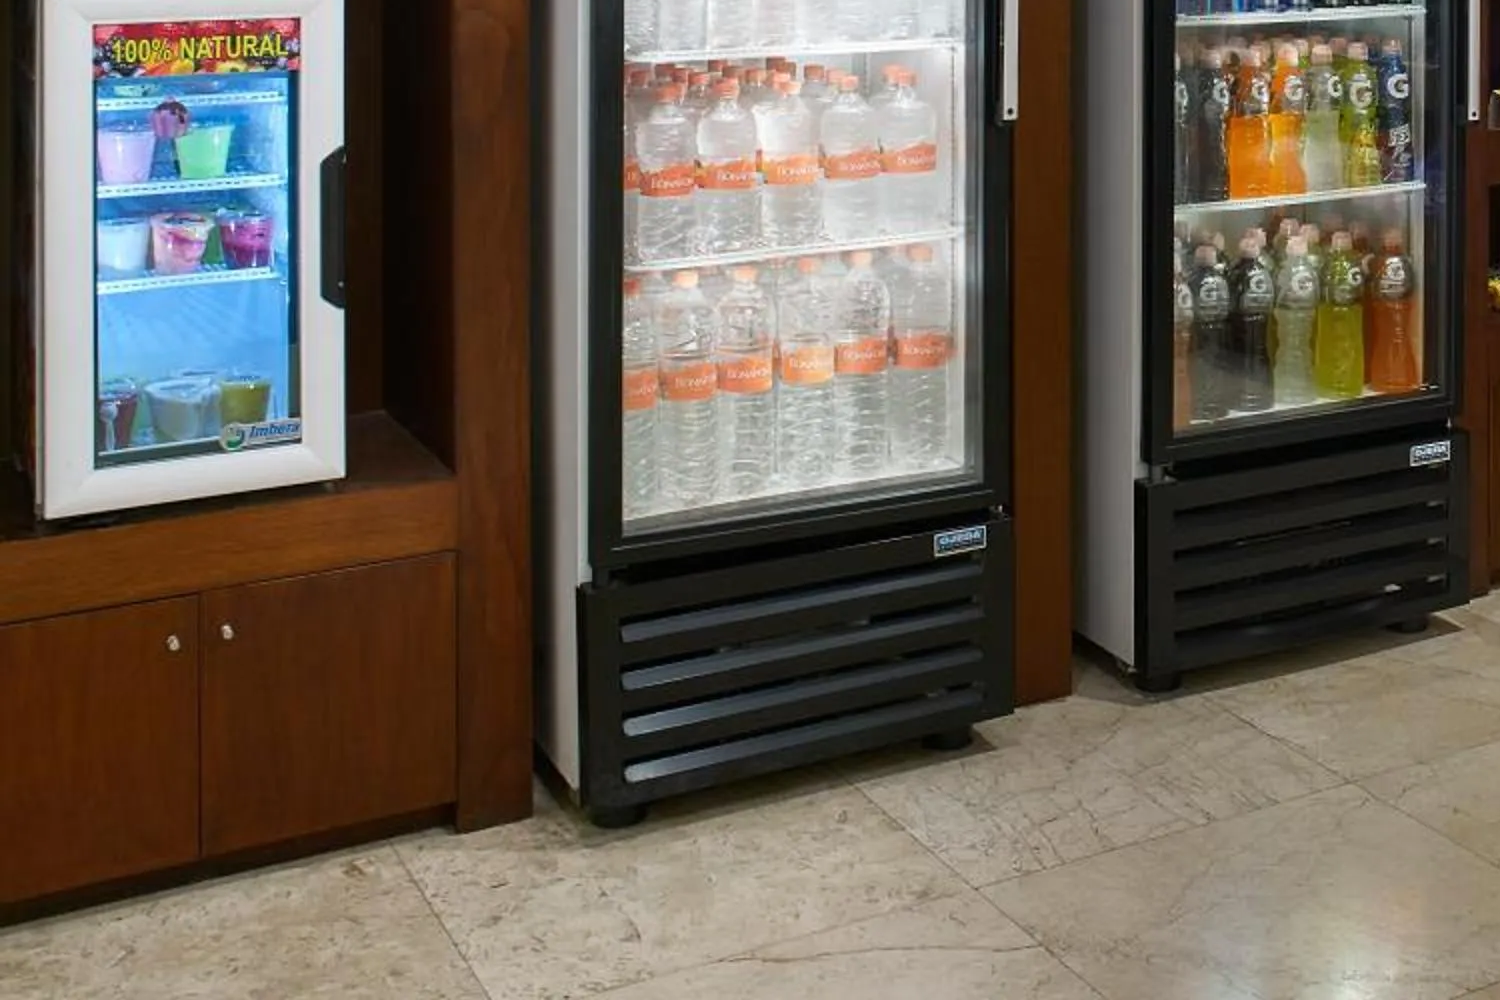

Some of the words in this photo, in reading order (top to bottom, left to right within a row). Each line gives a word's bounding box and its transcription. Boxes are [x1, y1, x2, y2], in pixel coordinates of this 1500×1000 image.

[111, 39, 173, 63] 100%
[179, 33, 289, 60] NATURAL
[1349, 79, 1373, 109] G
[1387, 73, 1409, 99] G
